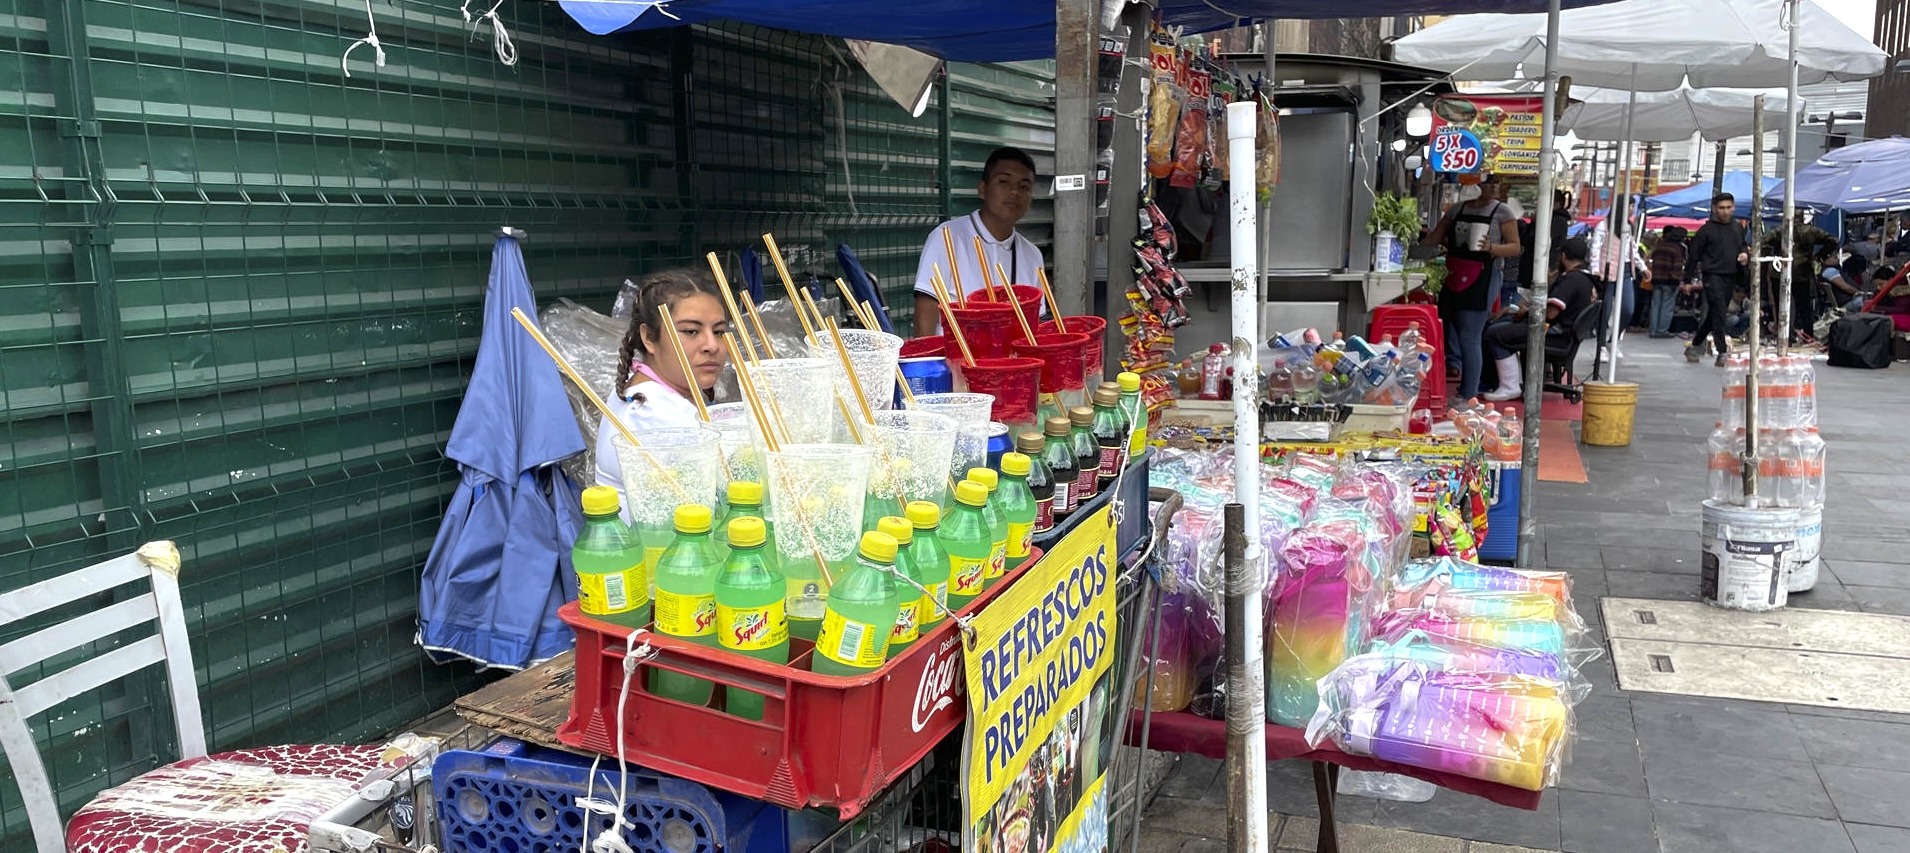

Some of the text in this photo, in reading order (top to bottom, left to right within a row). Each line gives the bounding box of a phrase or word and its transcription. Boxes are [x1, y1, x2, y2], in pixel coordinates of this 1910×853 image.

[1436, 134, 1462, 151] 5 X
[1442, 148, 1477, 170] $50
[956, 563, 985, 592] Squirt
[734, 610, 769, 646] Squirt
[982, 544, 1107, 712] REFRESCOS
[985, 611, 1107, 783] PREPARADOS
